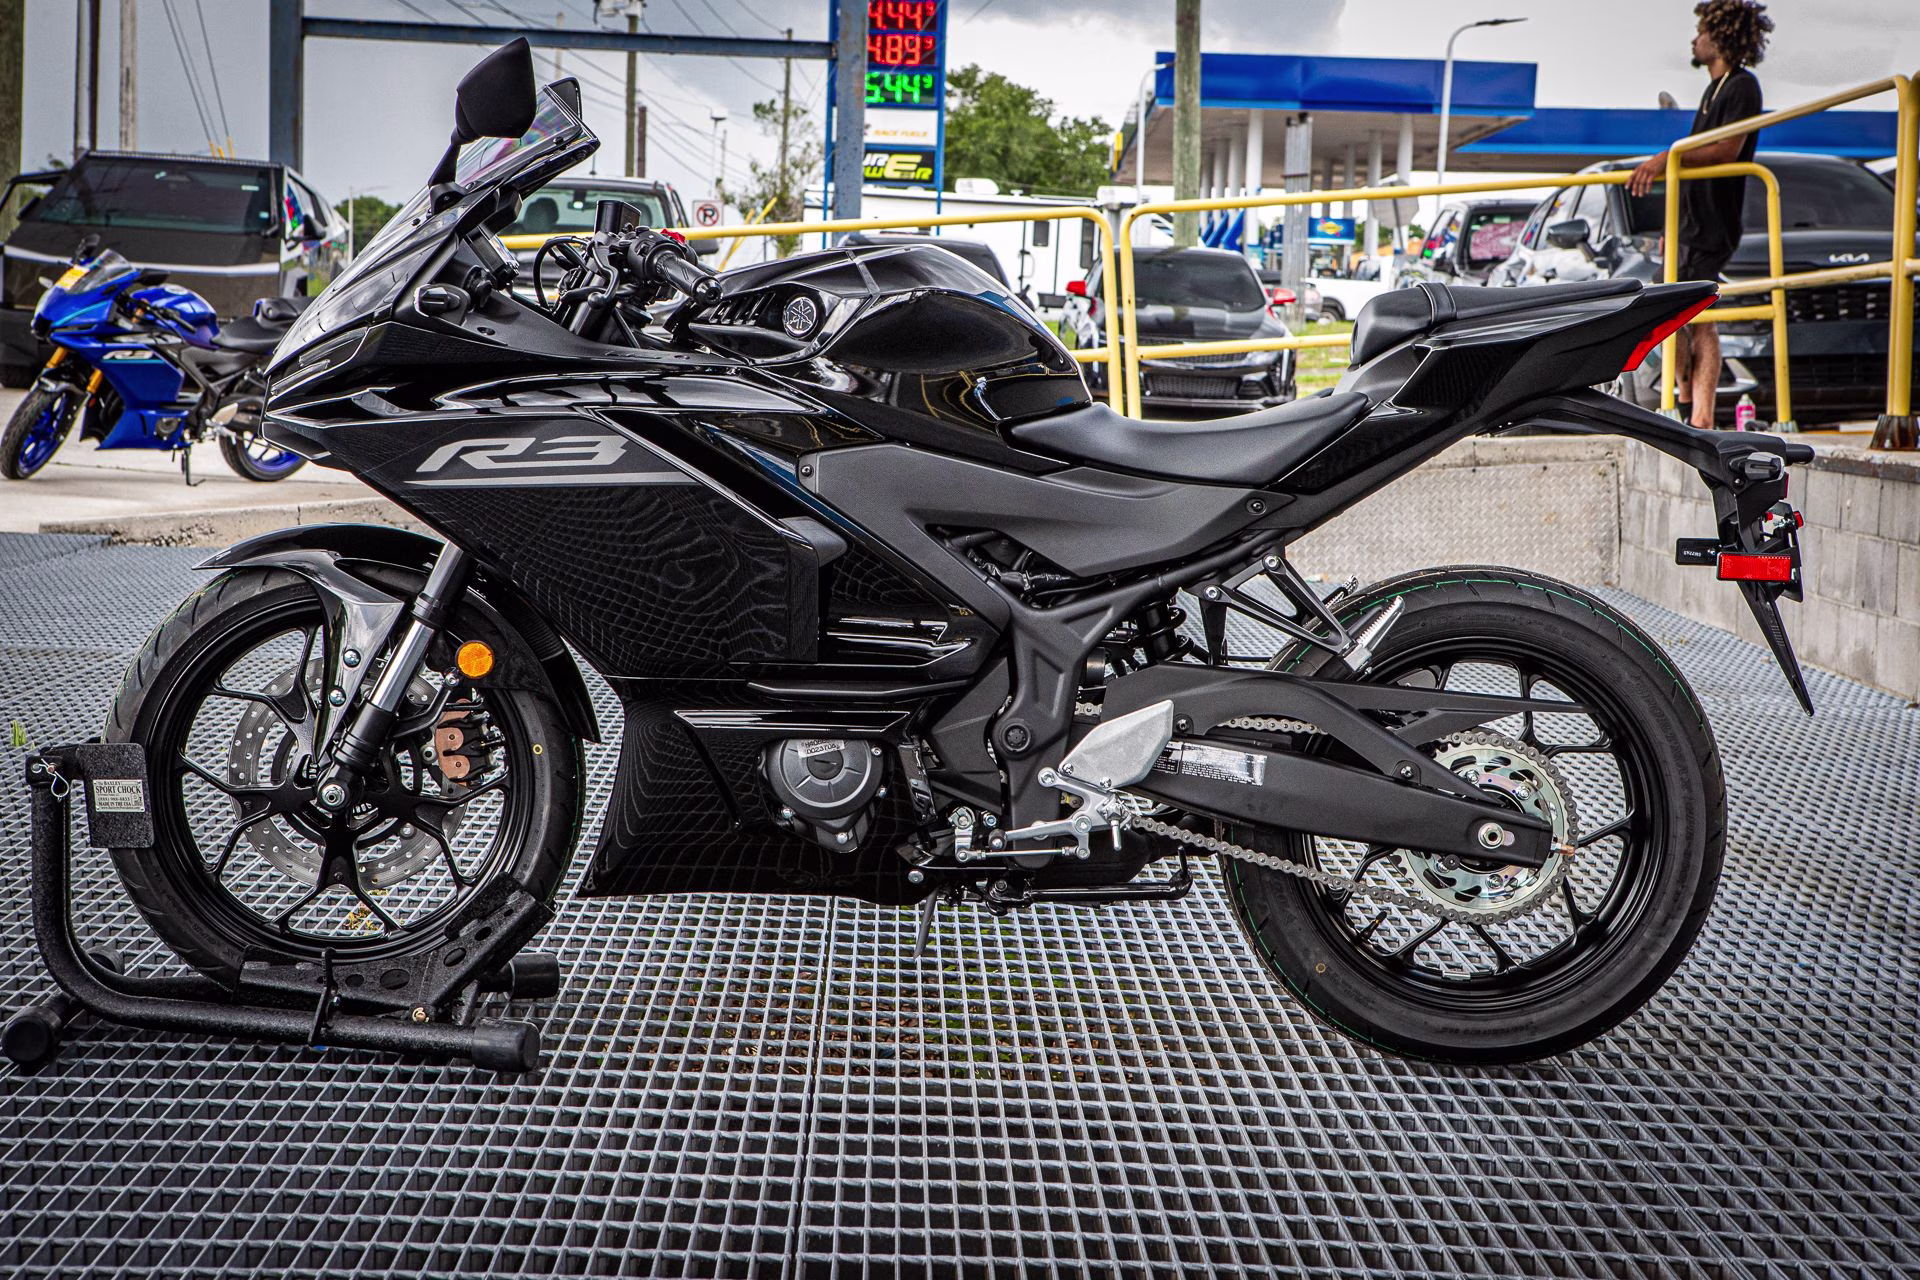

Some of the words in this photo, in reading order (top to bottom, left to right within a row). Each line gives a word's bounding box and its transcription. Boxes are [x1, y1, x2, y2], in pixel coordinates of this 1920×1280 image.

[416, 435, 629, 473] R3
[96, 785, 116, 793] SPORT
[117, 785, 141, 794] CHOCK
